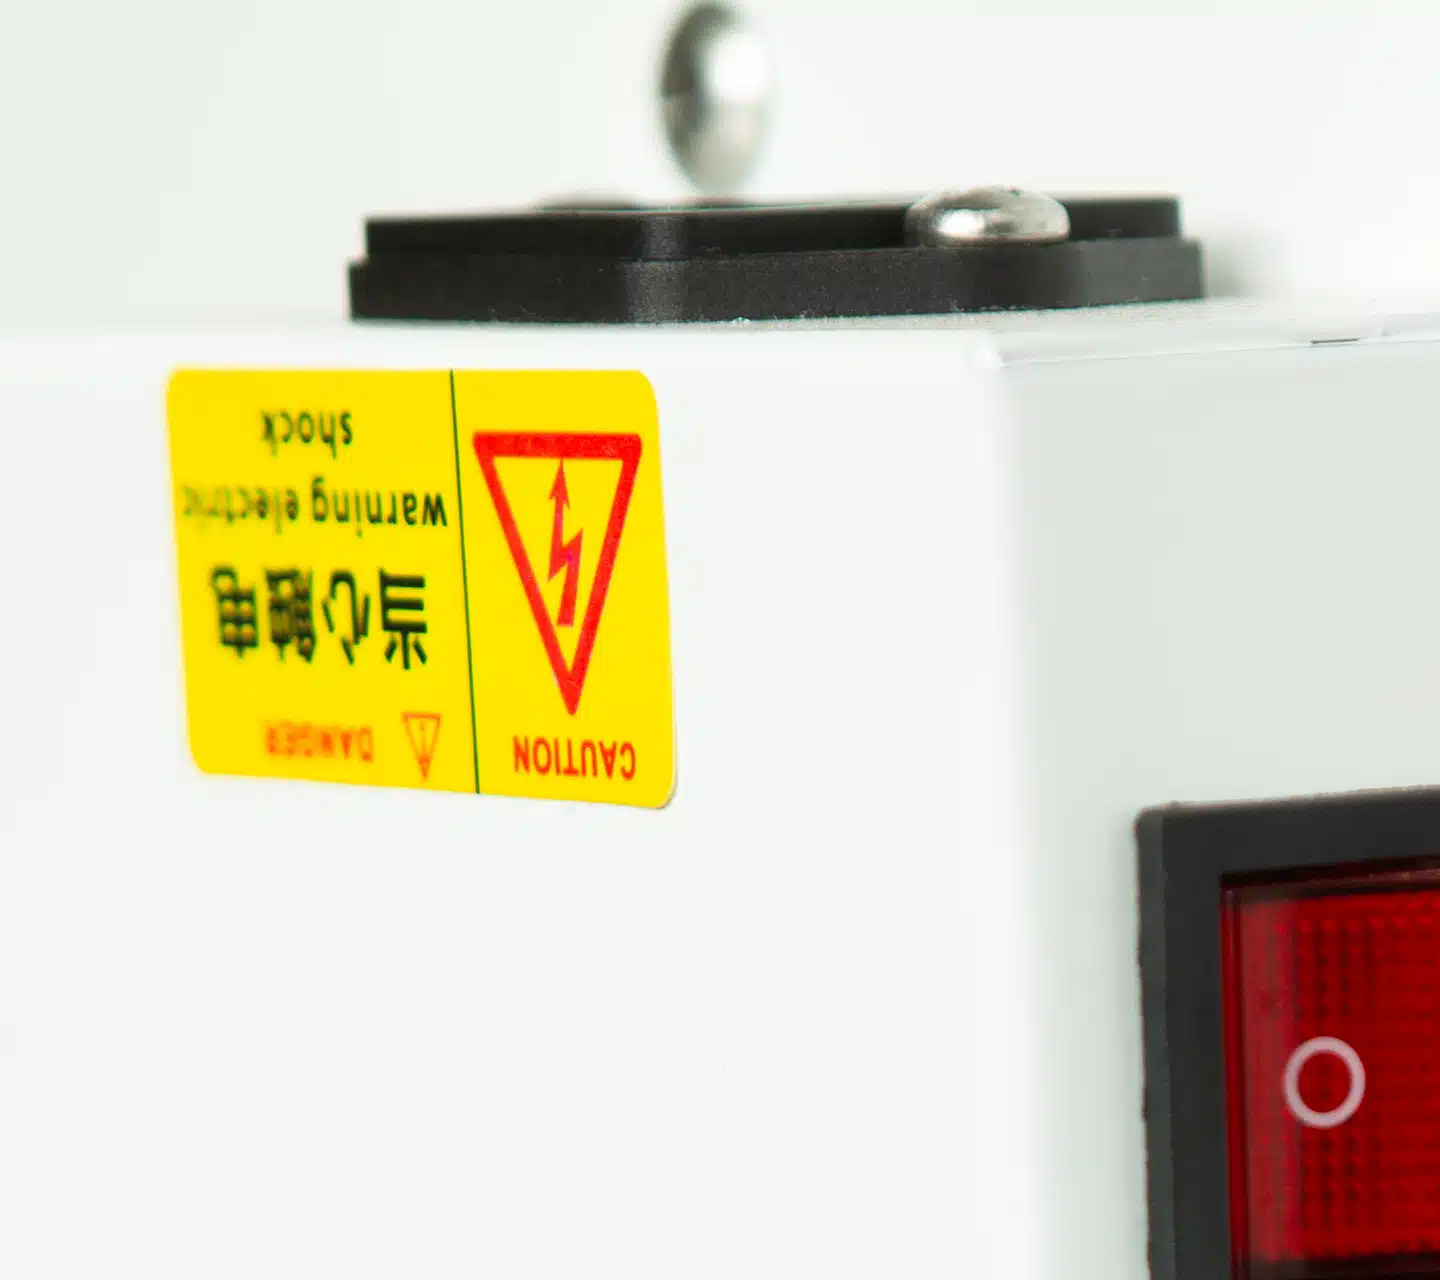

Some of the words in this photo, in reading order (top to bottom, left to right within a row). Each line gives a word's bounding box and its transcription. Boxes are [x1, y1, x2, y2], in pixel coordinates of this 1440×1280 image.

[260, 408, 354, 459] shock
[181, 482, 300, 535] electric
[312, 475, 449, 539] warning
[210, 566, 429, 671] 当心触电
[264, 720, 375, 764] DANGER
[513, 735, 637, 781] CAUTION
